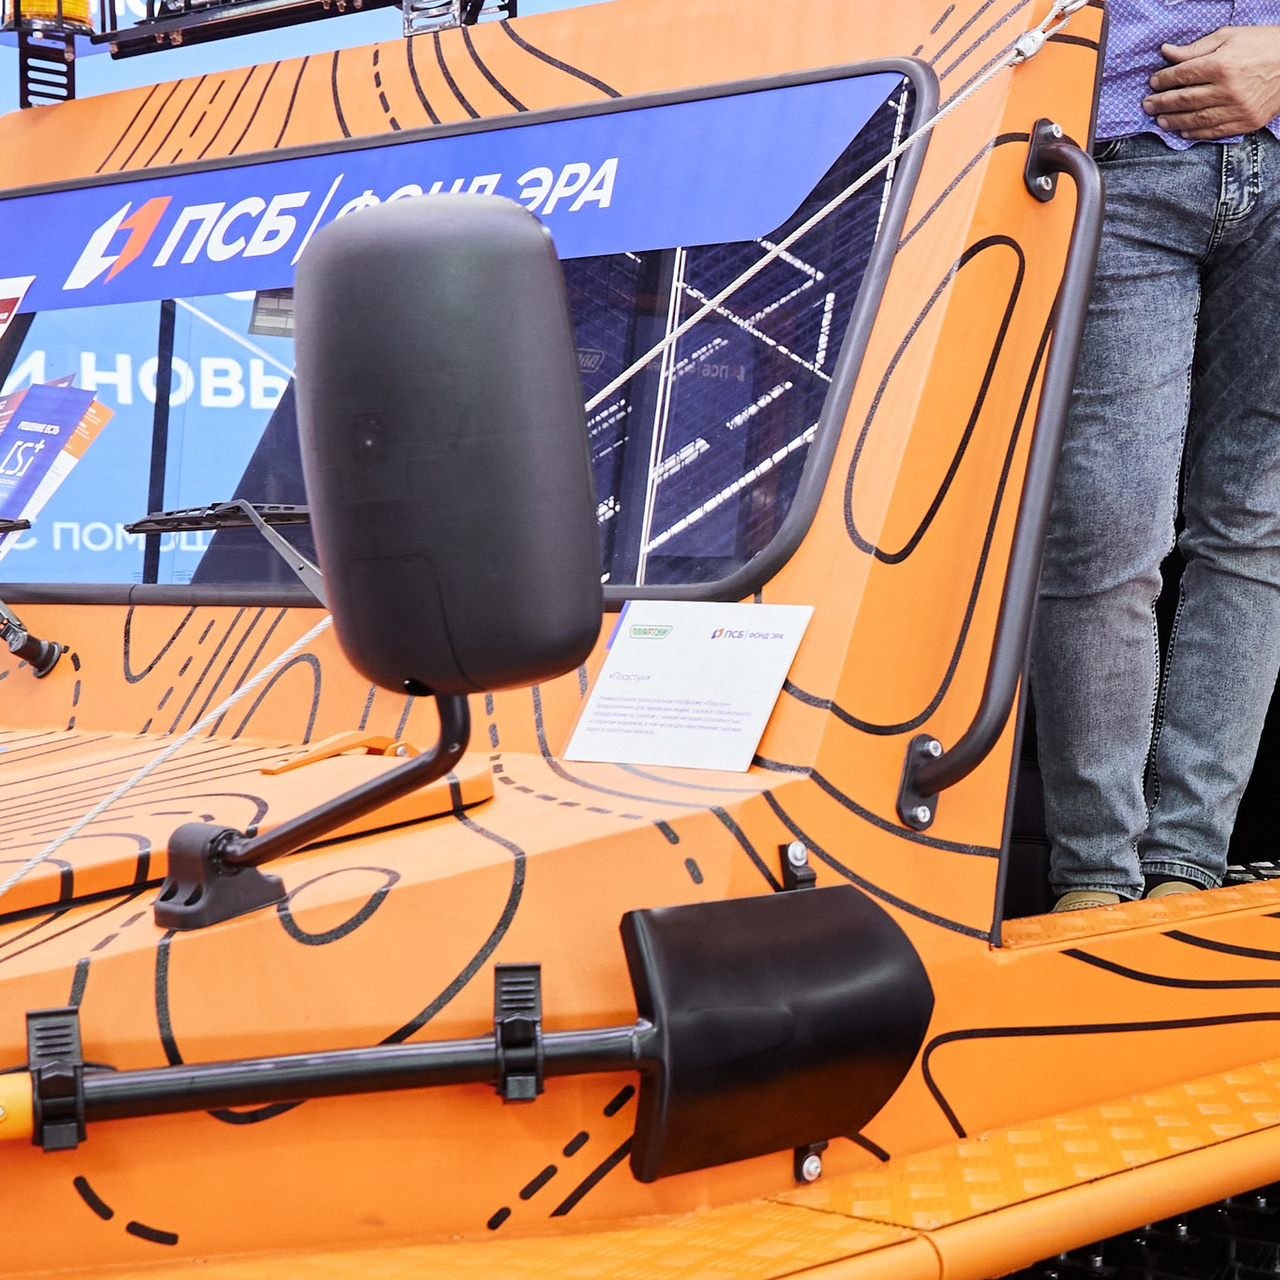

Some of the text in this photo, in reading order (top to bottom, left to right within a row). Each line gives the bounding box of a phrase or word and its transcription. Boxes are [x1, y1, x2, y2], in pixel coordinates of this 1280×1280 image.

[152, 190, 311, 268] ПСБ
[516, 157, 618, 215] ЭРА
[723, 630, 745, 639] ПСБ
